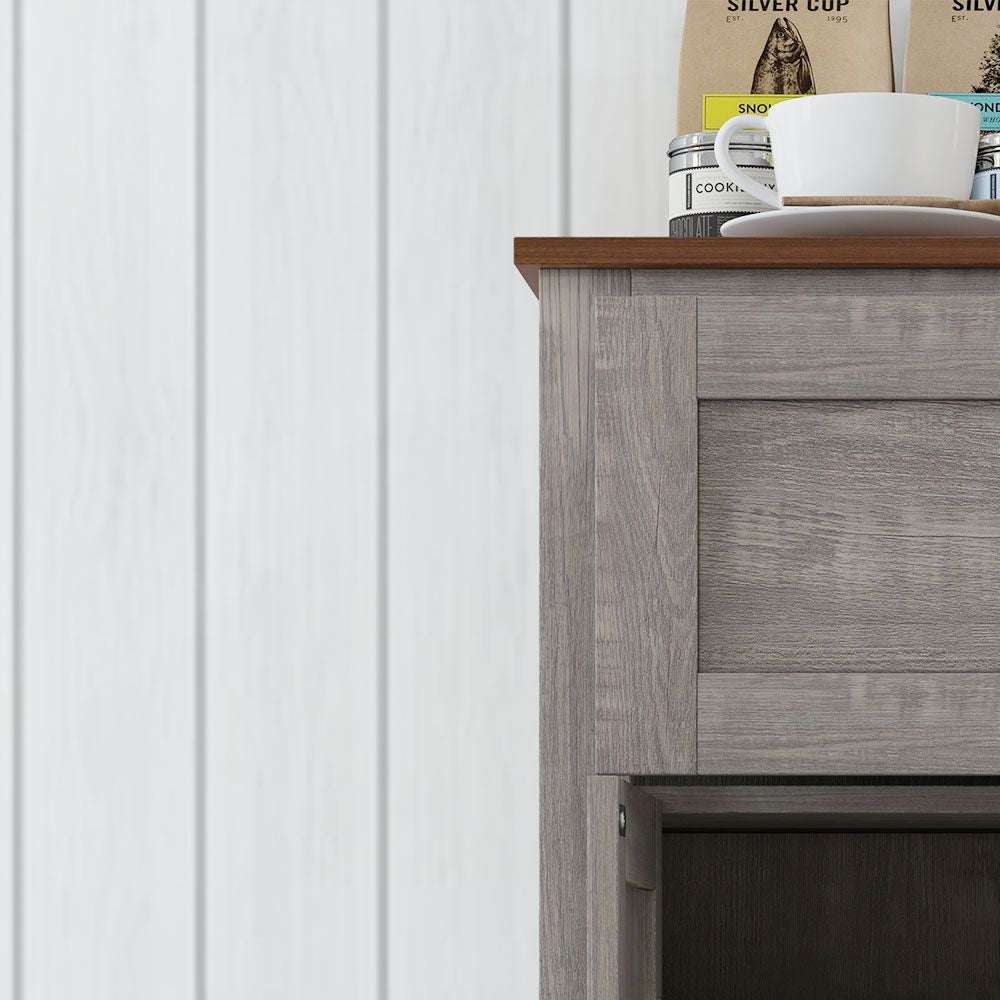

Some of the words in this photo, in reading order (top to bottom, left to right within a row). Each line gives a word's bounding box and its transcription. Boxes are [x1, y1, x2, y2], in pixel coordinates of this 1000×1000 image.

[727, 0, 798, 11] SILVER
[807, 0, 849, 11] CUP
[738, 103, 771, 114] SNO
